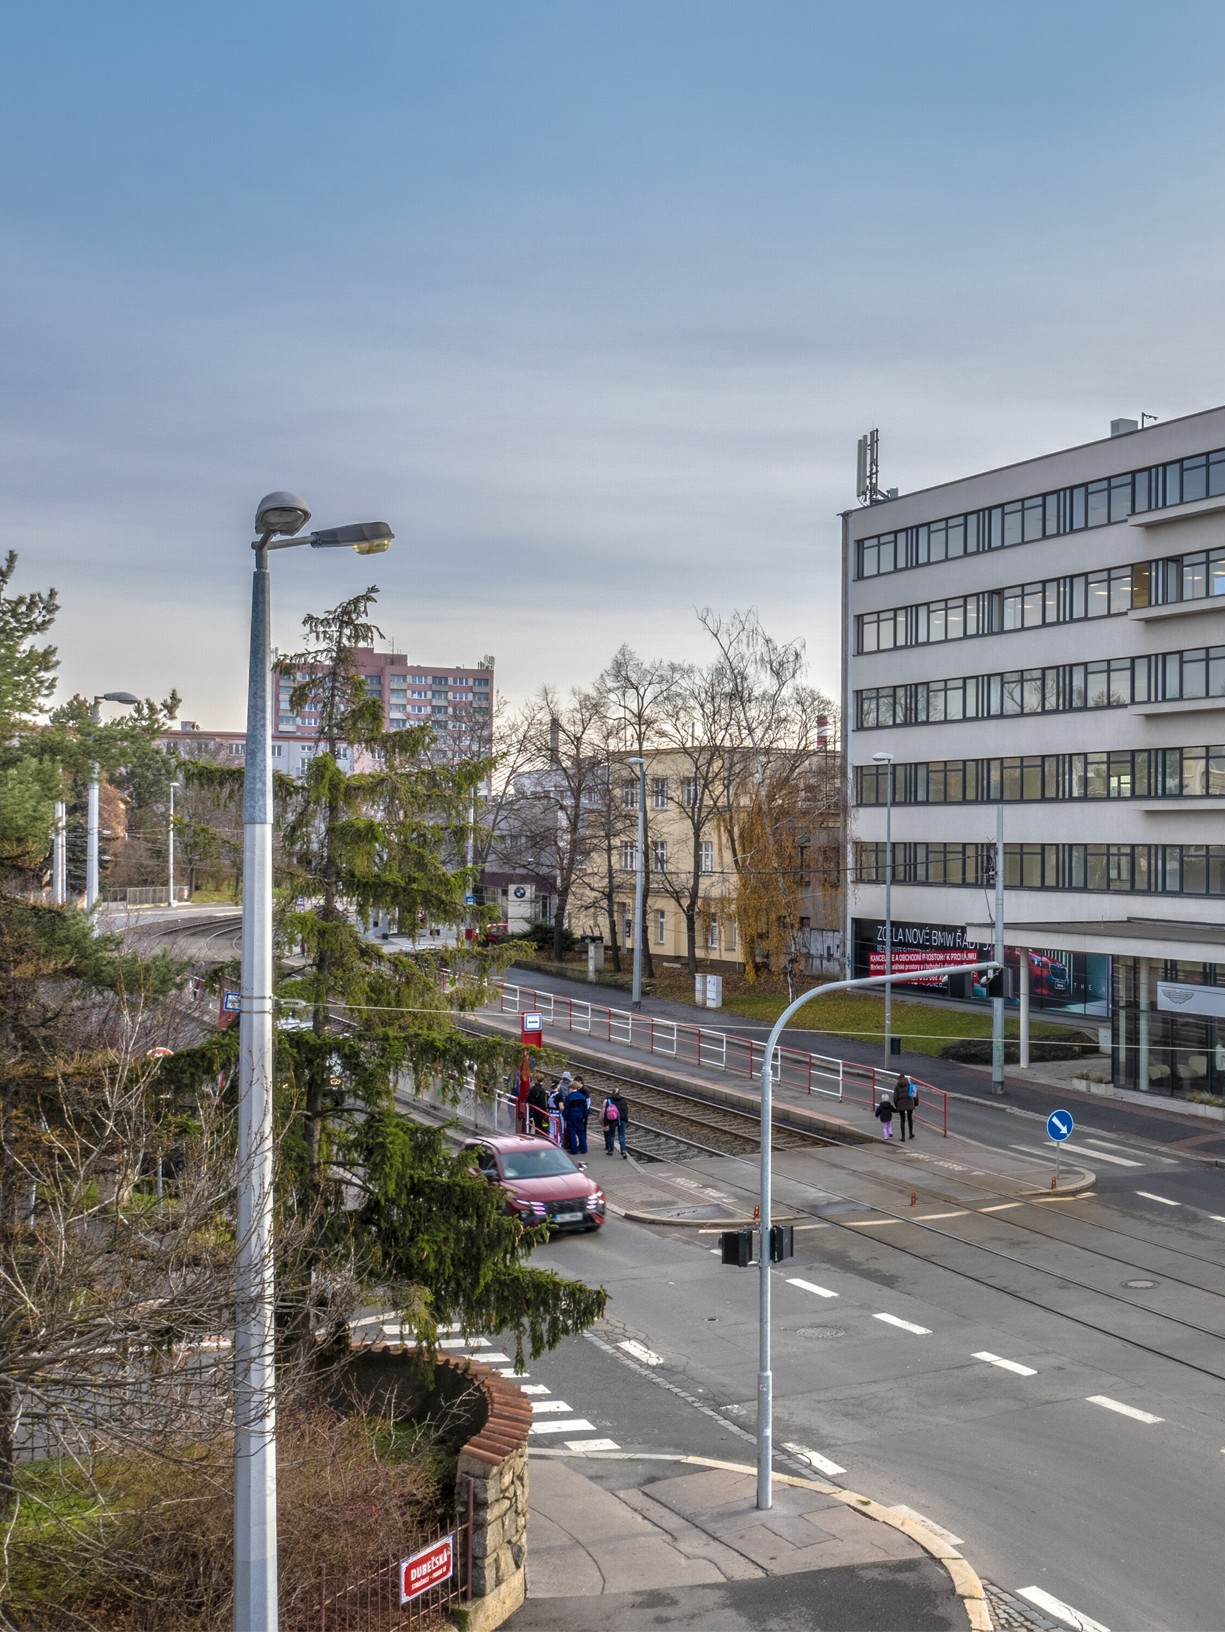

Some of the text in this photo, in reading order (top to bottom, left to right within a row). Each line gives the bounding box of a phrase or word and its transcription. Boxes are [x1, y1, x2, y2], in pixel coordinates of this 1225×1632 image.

[877, 926, 903, 942] ZCLA
[905, 927, 930, 945] NOVÉ
[931, 930, 955, 947] BMW
[870, 954, 896, 962] KANCELE
[1073, 982, 1092, 991] THE
[410, 1549, 448, 1581] DUBEČSKÁ
